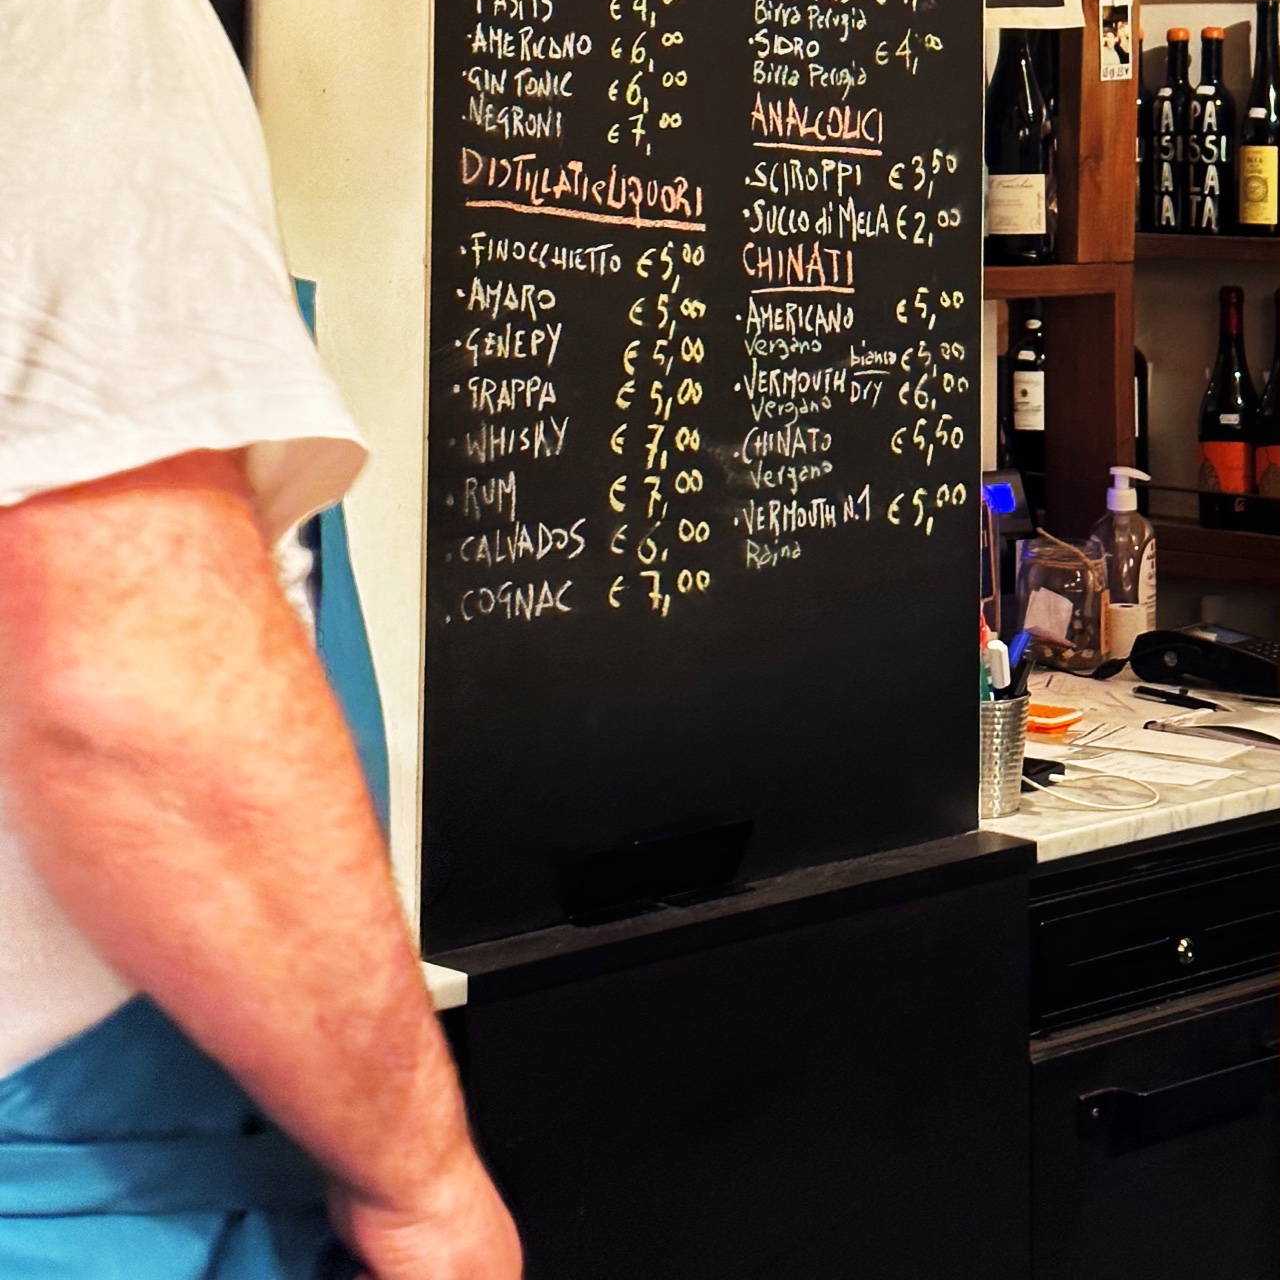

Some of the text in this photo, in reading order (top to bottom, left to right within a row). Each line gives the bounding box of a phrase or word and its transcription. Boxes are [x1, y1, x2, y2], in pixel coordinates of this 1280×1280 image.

[472, 23, 592, 62] AMERICANO
[755, 28, 820, 60] SIDRO
[468, 67, 573, 97] GIN TONIC
[809, 60, 867, 101] Perugia
[469, 93, 562, 139] NEGRONI
[752, 91, 883, 144] ANALCOLICI
[607, 164, 703, 220] LIQUORI
[748, 159, 862, 197] SCIROPPI
[750, 199, 810, 235] SUCCO
[815, 201, 833, 235] di
[839, 196, 889, 241] MELA
[471, 232, 621, 276] FINOCCHIETTO
[742, 241, 853, 286] CHINATI
[467, 277, 556, 321] AMARO
[746, 297, 854, 336] AMERICANO
[467, 322, 561, 367] GENEPY
[745, 334, 822, 360] Vergano
[468, 376, 557, 415] GRAPPA
[743, 358, 846, 400] VERMOUTH
[752, 396, 832, 425] Vergano
[467, 416, 569, 464] WHISKY
[742, 425, 832, 464] CHINATO
[464, 471, 515, 522] RUM
[751, 460, 833, 495] Vergano
[743, 499, 836, 537] VERMOUTH
[460, 518, 586, 567] CALVADOS
[461, 580, 572, 621] COGNAC
